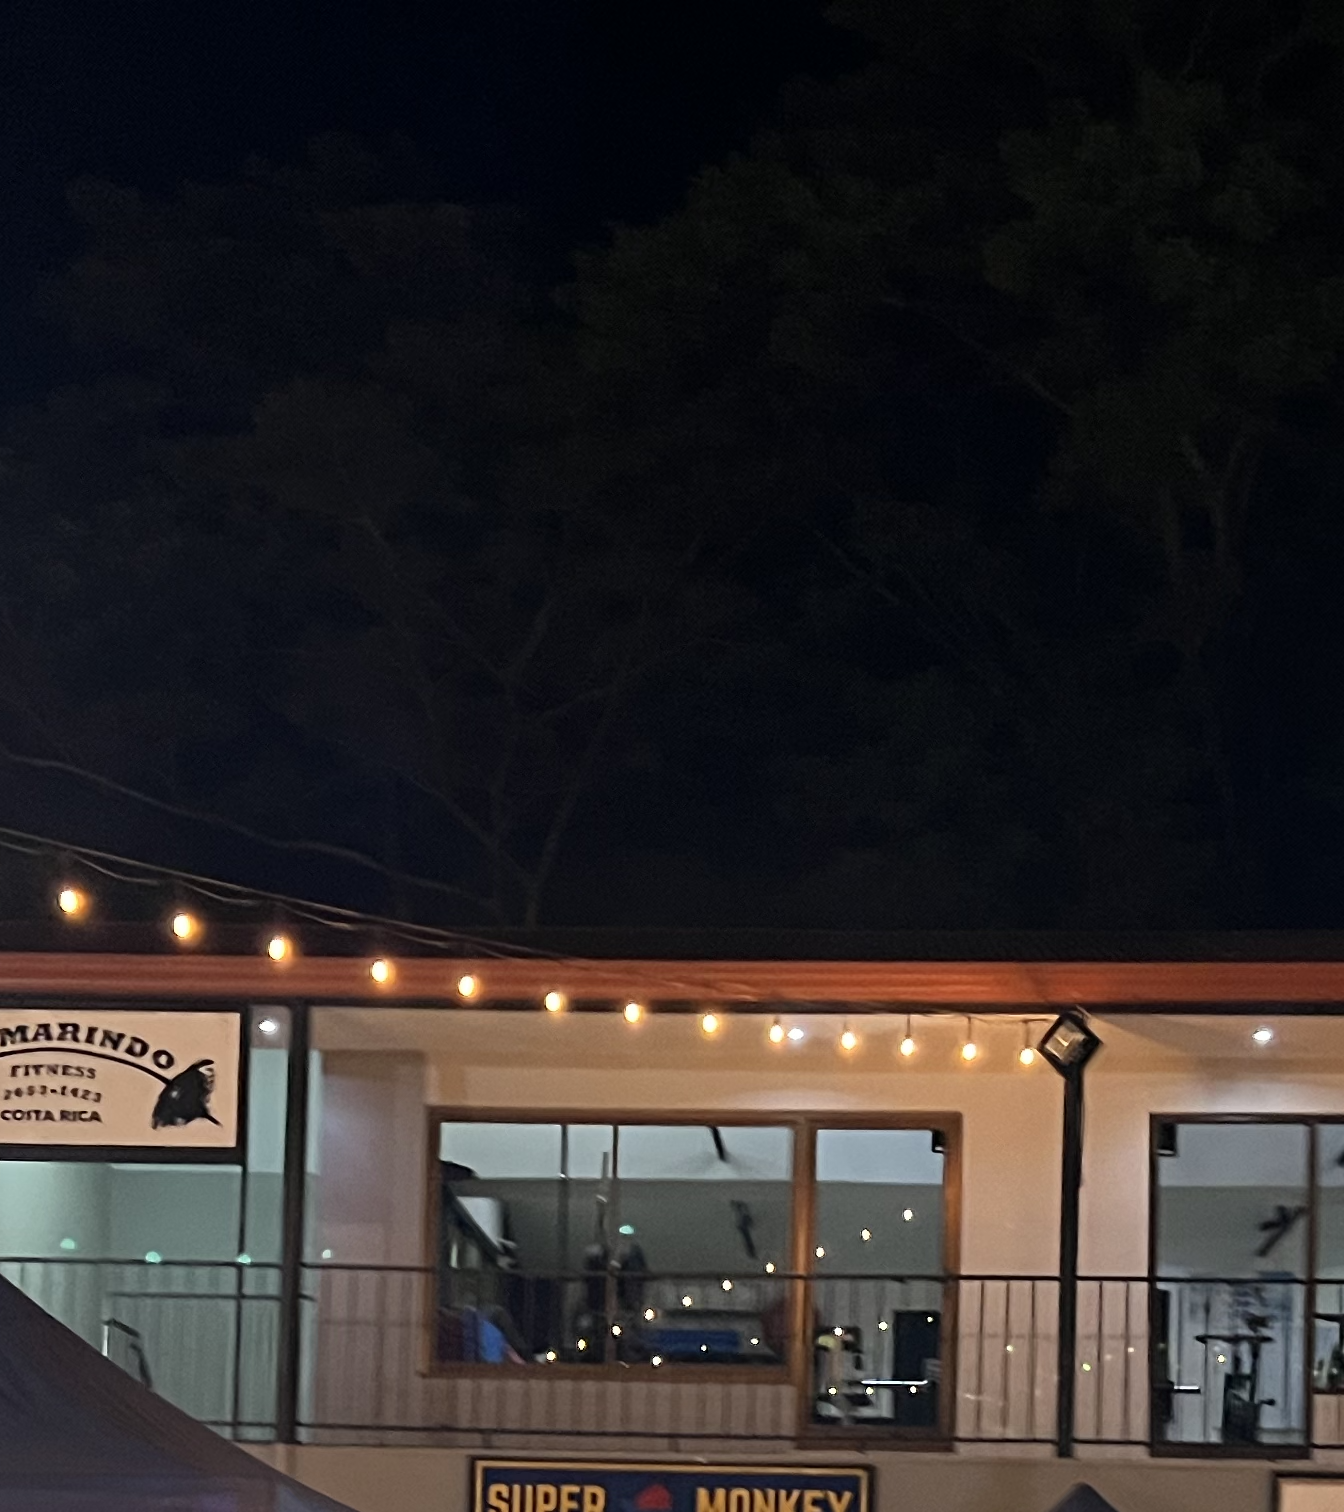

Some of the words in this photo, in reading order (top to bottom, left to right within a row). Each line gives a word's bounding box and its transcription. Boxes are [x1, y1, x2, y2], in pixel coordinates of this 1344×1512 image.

[10, 1065, 96, 1079] FITNESS
[0, 1109, 56, 1122] COSTA
[59, 1109, 103, 1123] RICA
